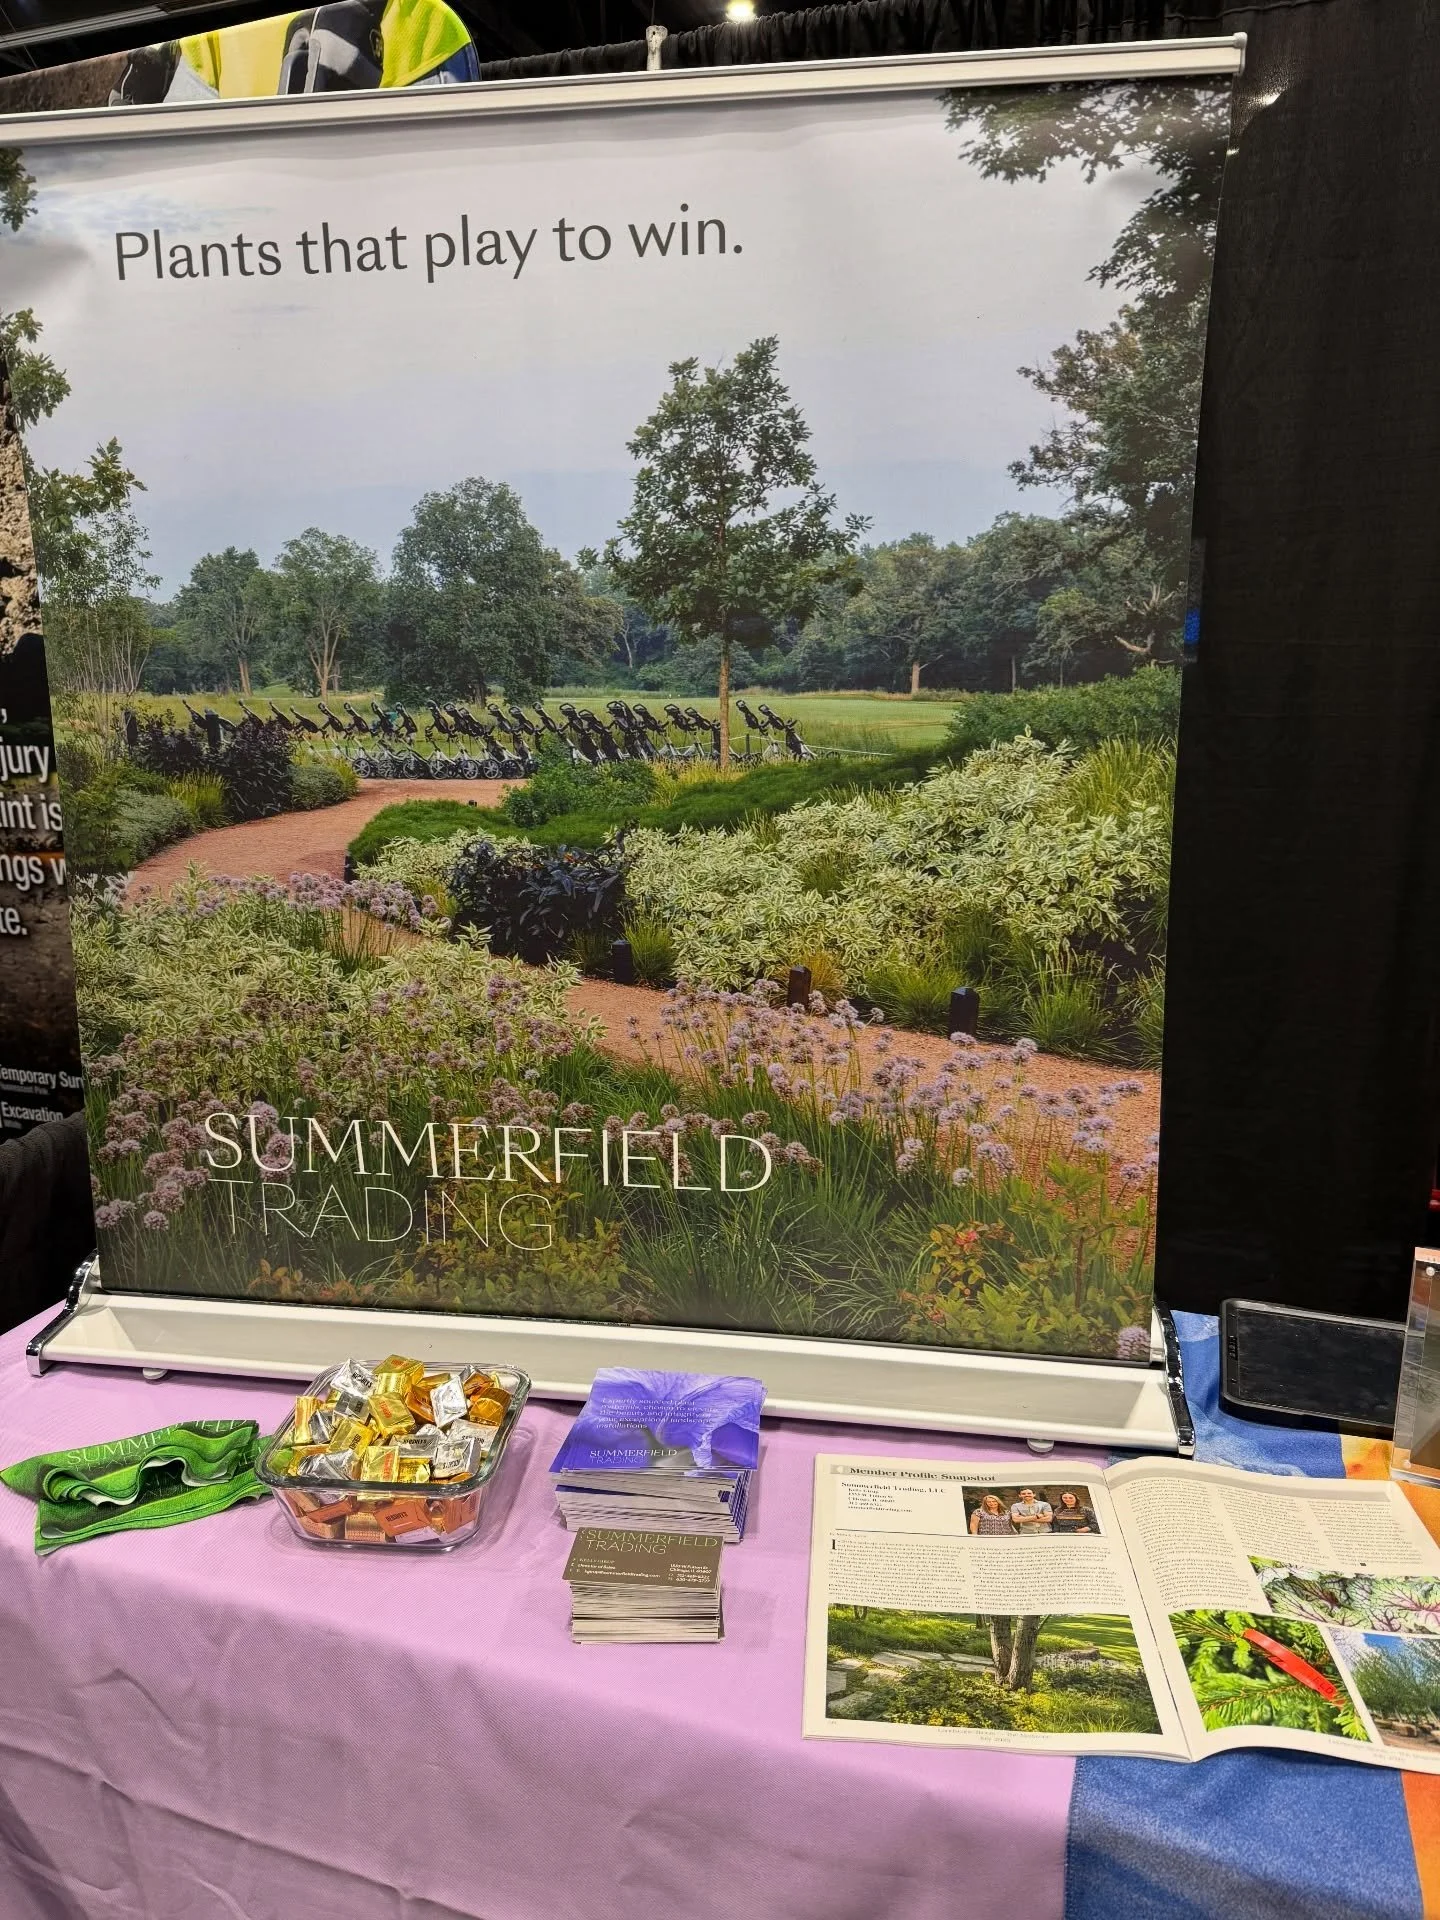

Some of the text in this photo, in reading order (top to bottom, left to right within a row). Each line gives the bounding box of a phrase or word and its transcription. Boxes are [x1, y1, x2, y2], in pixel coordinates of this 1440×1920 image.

[115, 203, 744, 283] Plants that play to win.
[0, 793, 63, 832] int is
[0, 1064, 57, 1089] emporary
[1, 1101, 64, 1122] Excavation
[205, 1112, 773, 1193] SUMMERFIELD
[207, 1178, 553, 1251] TRADING
[589, 1449, 677, 1457] SUMMERFIELD
[589, 1456, 645, 1464] TRADING
[850, 1467, 996, 1482] Member Profile Snapshot
[586, 1530, 718, 1547] SUMMERFIELD
[586, 1540, 667, 1555] TRADING
